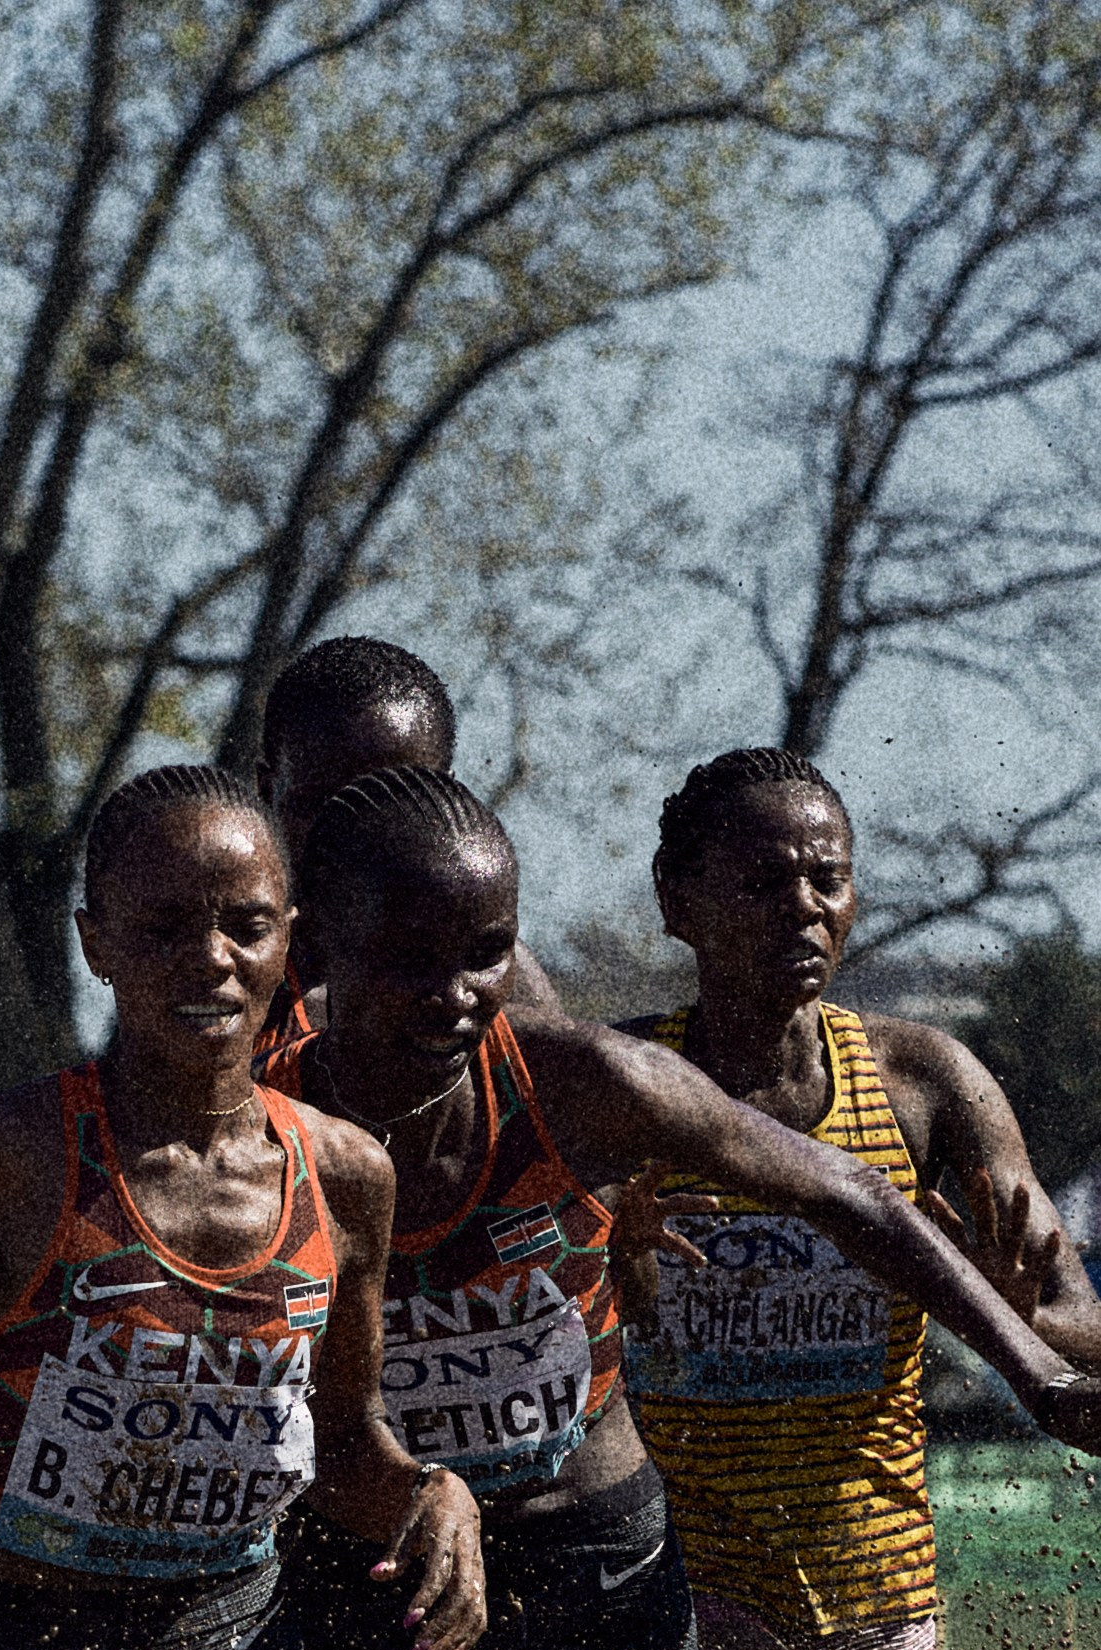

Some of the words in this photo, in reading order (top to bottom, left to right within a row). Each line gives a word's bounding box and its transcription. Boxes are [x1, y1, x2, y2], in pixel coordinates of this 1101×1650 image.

[66, 1315, 312, 1387] KENYA
[62, 1386, 293, 1446] SONY
[387, 1375, 578, 1455] ETICH
[27, 1438, 76, 1509] B.
[99, 1461, 303, 1527] CHEBET
